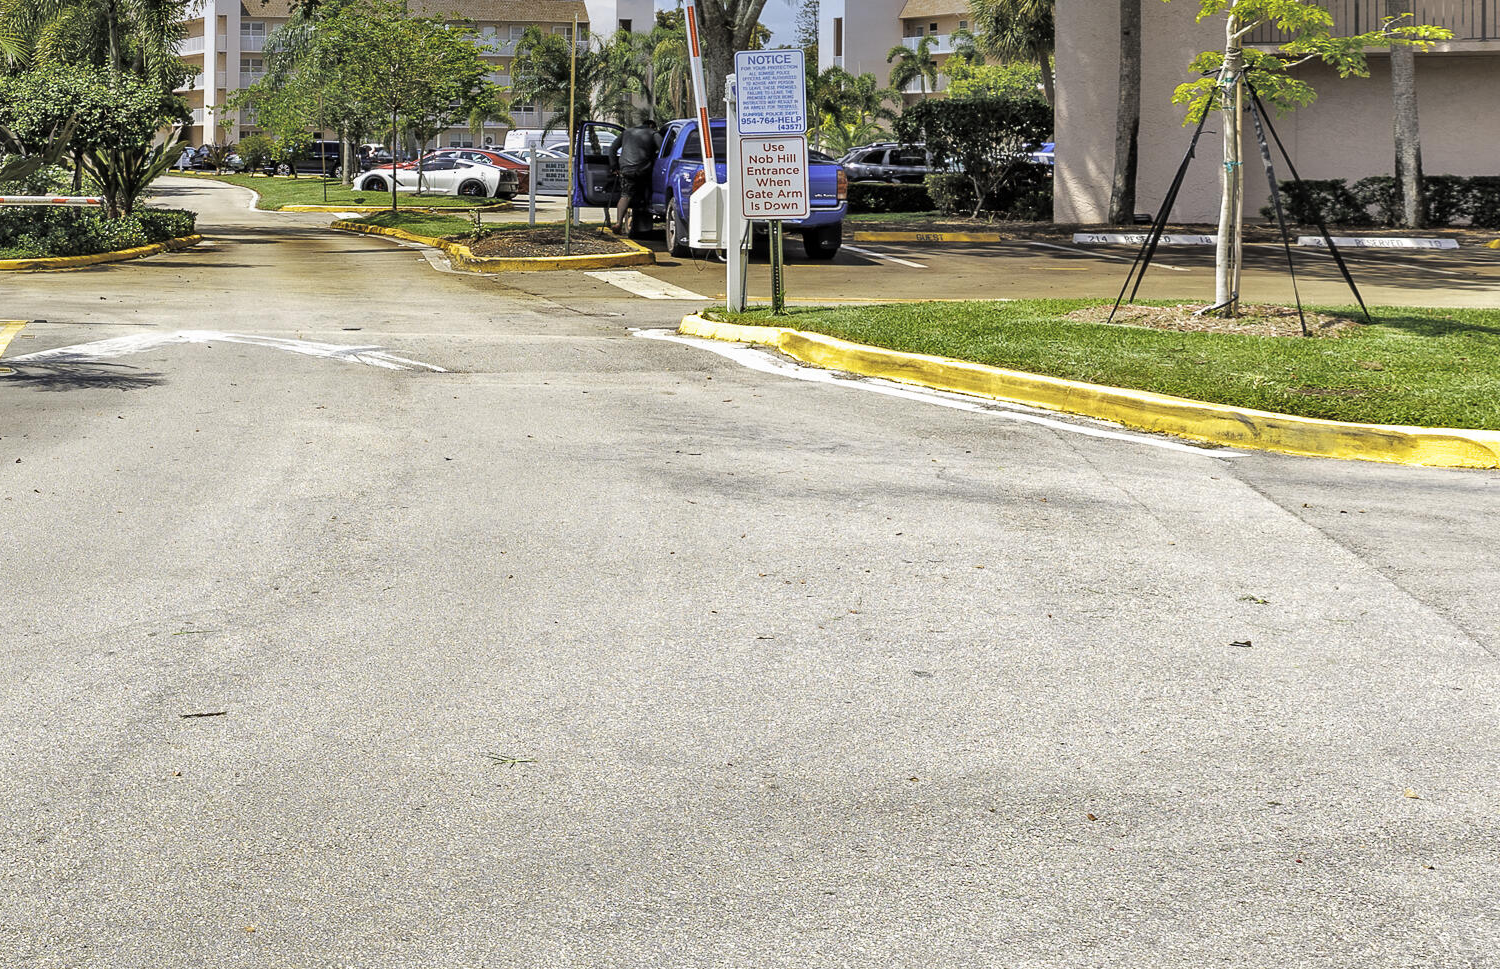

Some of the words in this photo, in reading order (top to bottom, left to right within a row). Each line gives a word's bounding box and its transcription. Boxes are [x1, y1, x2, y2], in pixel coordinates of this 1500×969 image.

[748, 54, 792, 65] NOTICE
[741, 116, 802, 125] 954-764-HELP
[763, 143, 785, 152] Use
[749, 154, 774, 164] Nob
[777, 153, 796, 163] Hill
[747, 166, 800, 176] Entrance
[756, 177, 791, 187] When
[746, 189, 774, 199] Gate
[777, 189, 803, 198] Arm
[750, 201, 760, 211] Is
[764, 201, 799, 211] Down
[916, 233, 944, 241] GUEST
[1354, 238, 1404, 247] RESERVED
